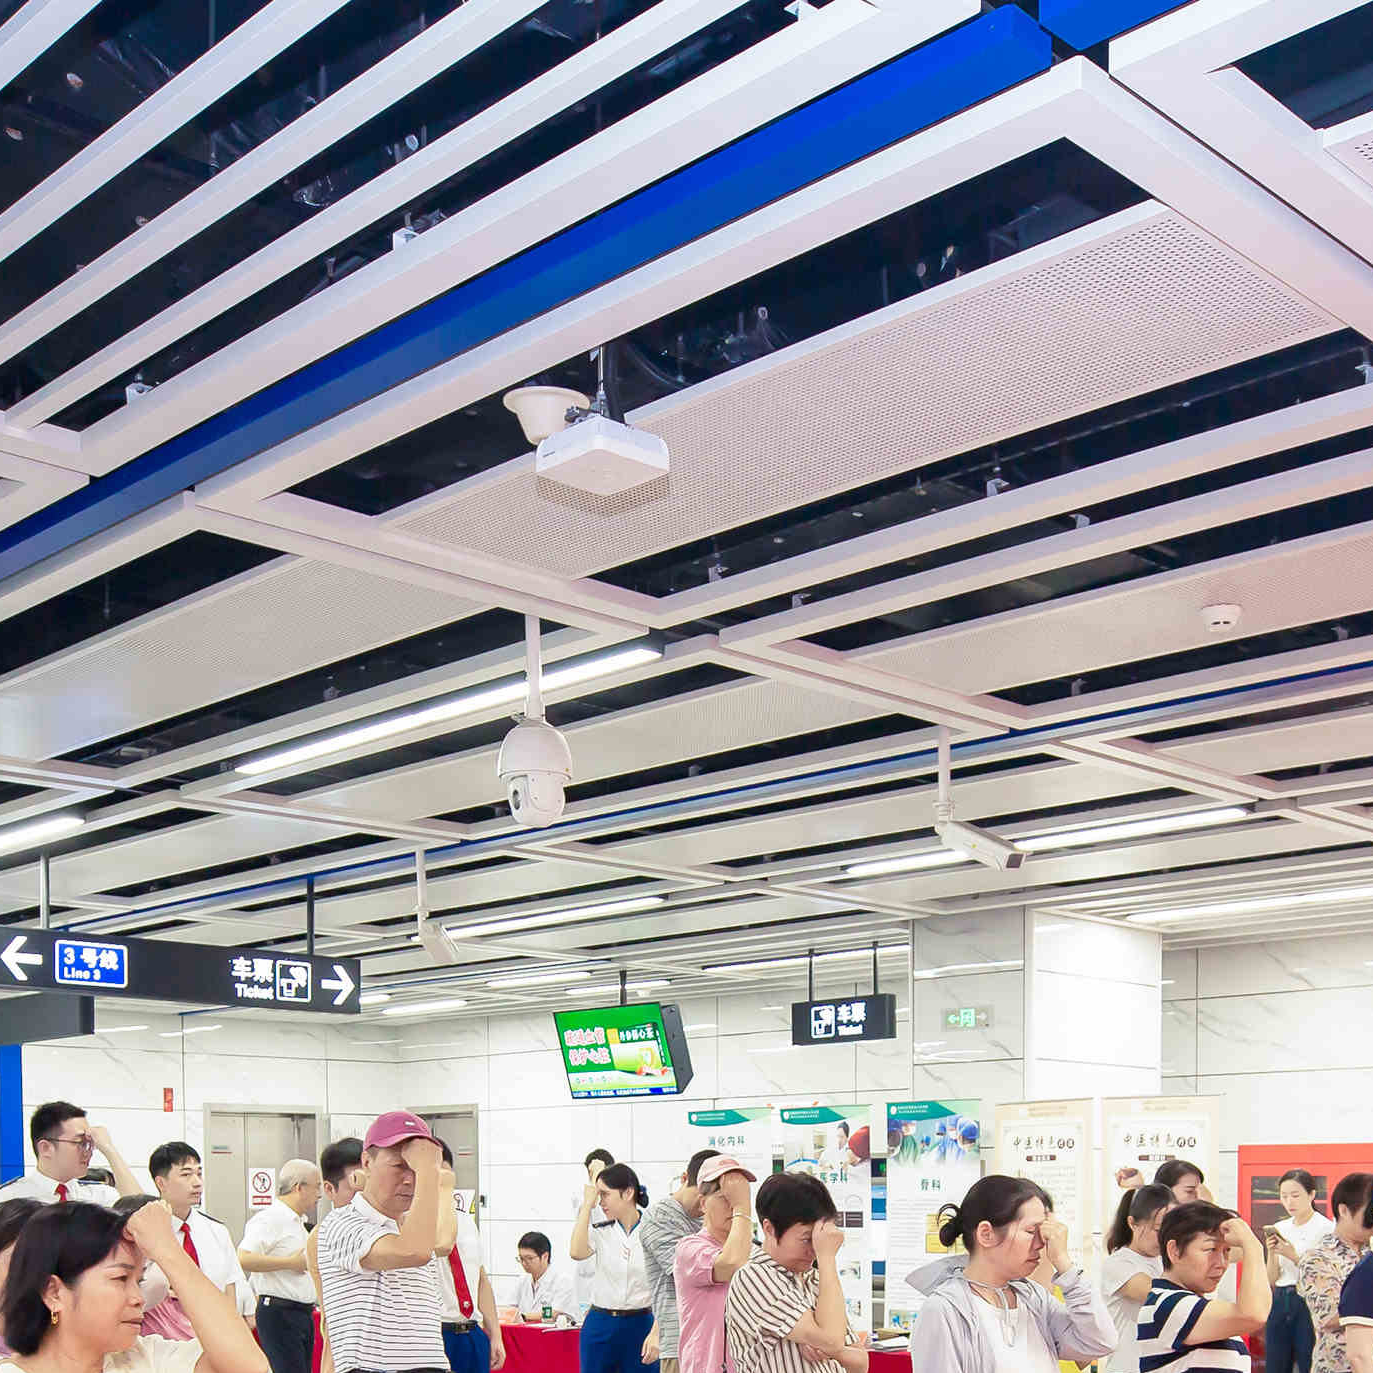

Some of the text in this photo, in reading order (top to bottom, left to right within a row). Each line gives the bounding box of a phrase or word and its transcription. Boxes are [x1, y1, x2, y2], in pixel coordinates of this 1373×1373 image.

[64, 966, 101, 980] Line 3
[231, 956, 274, 983] 车票
[235, 983, 274, 1000] Ticket
